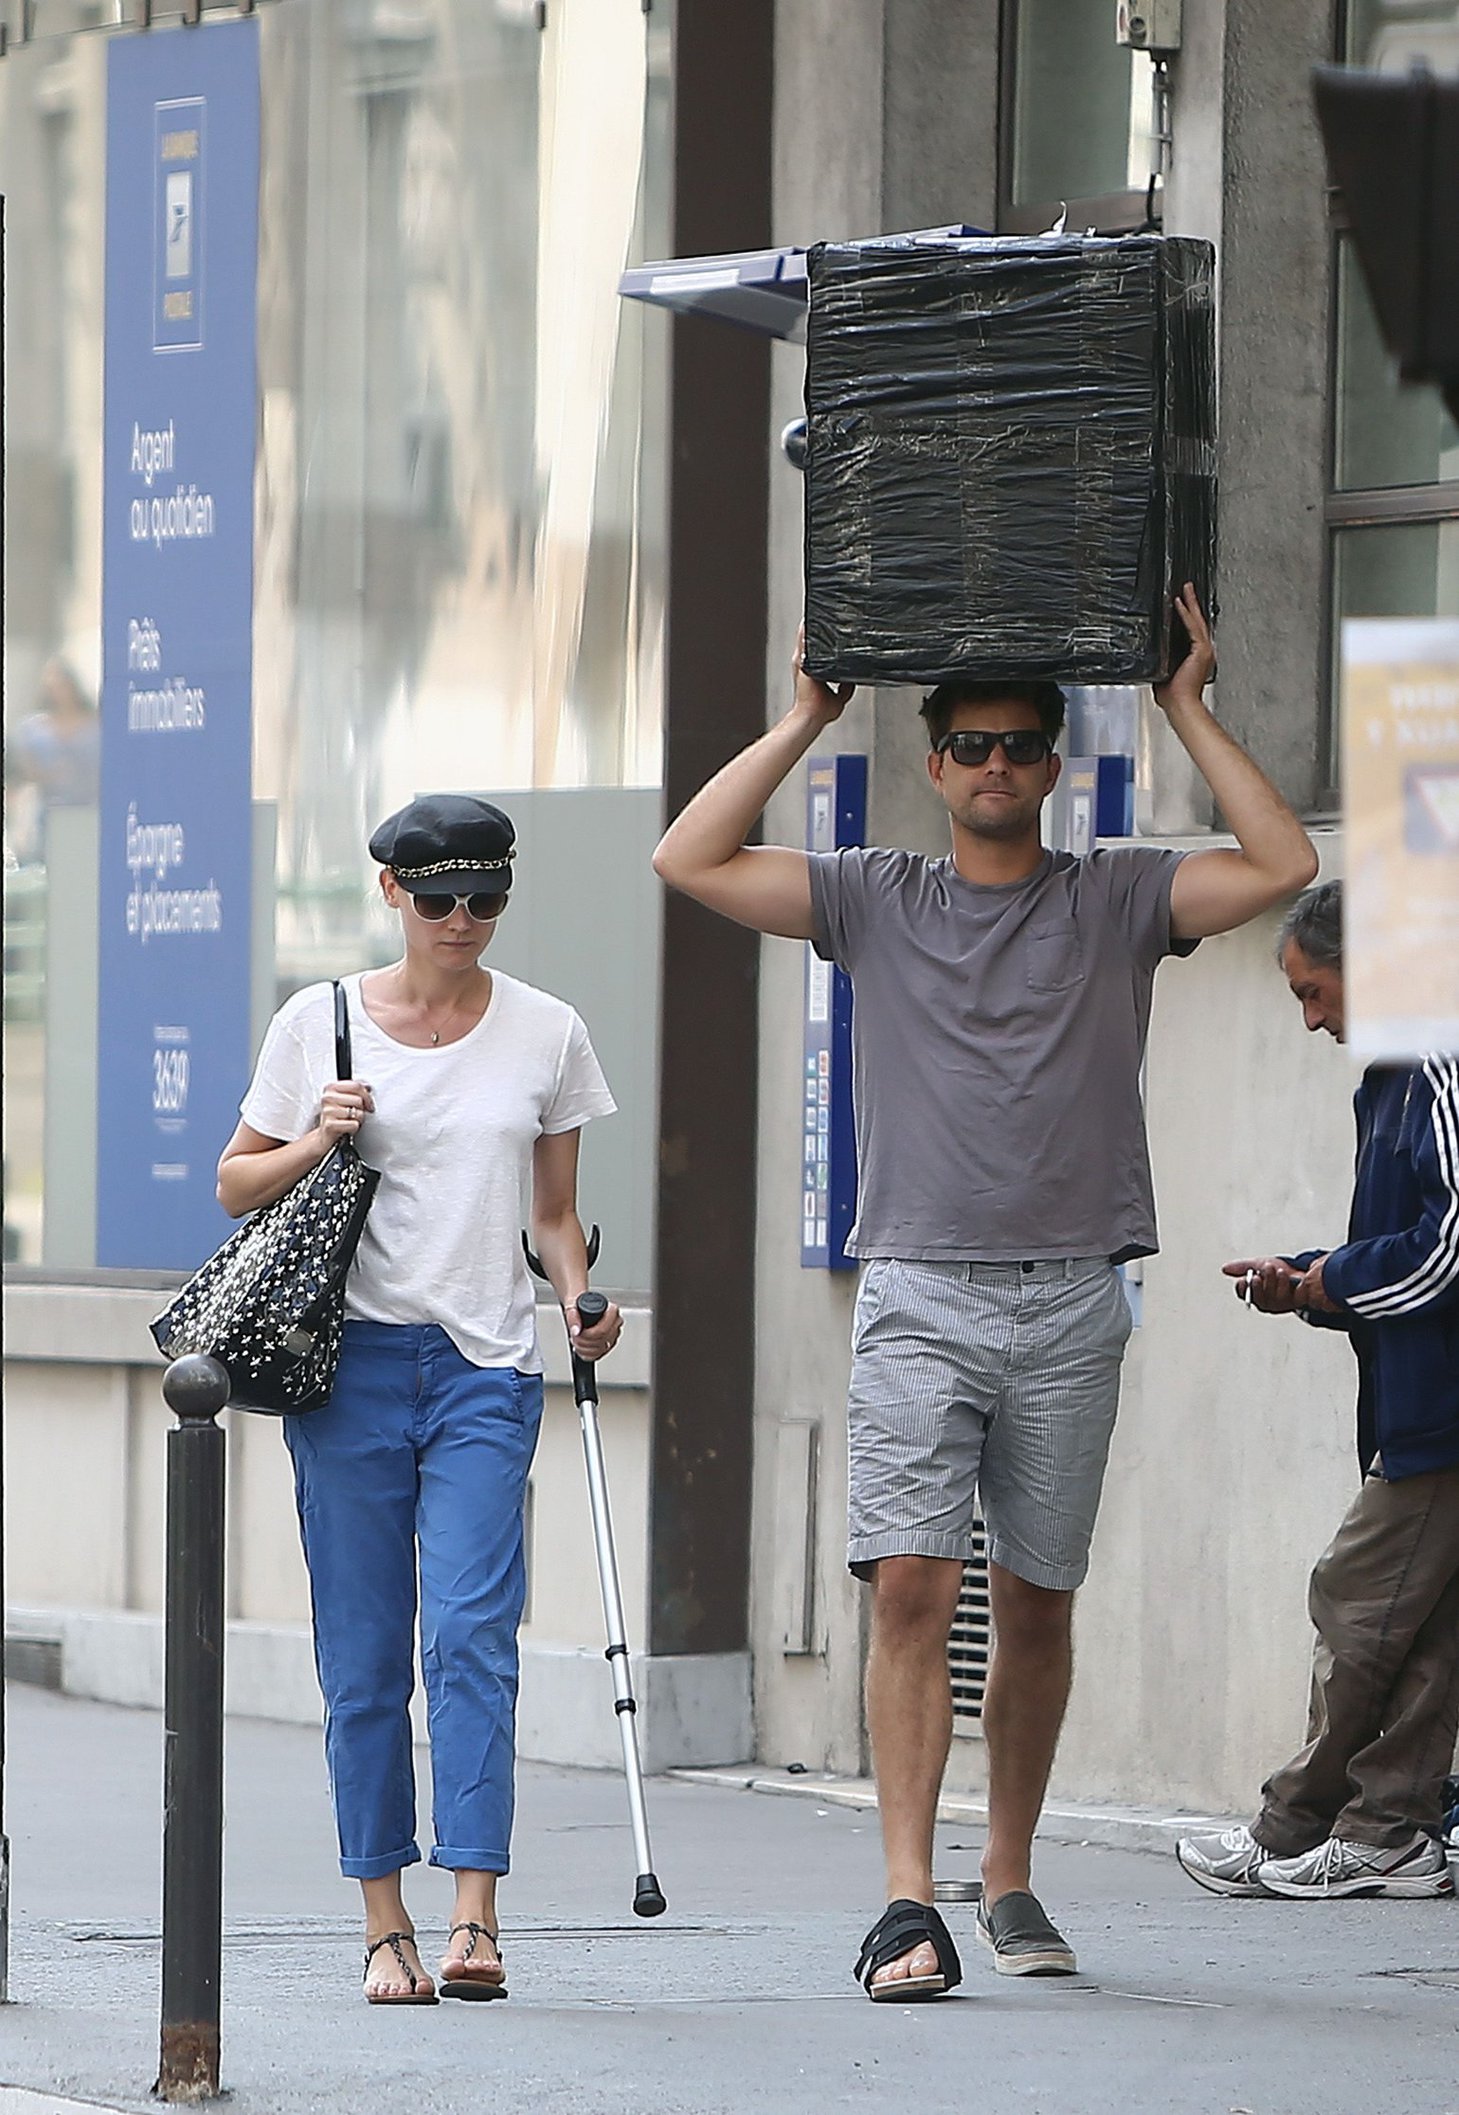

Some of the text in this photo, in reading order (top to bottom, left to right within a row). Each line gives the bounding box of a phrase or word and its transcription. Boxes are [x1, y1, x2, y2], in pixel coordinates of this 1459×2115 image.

[130, 418, 175, 486] Argent
[130, 483, 214, 550] au quotidien
